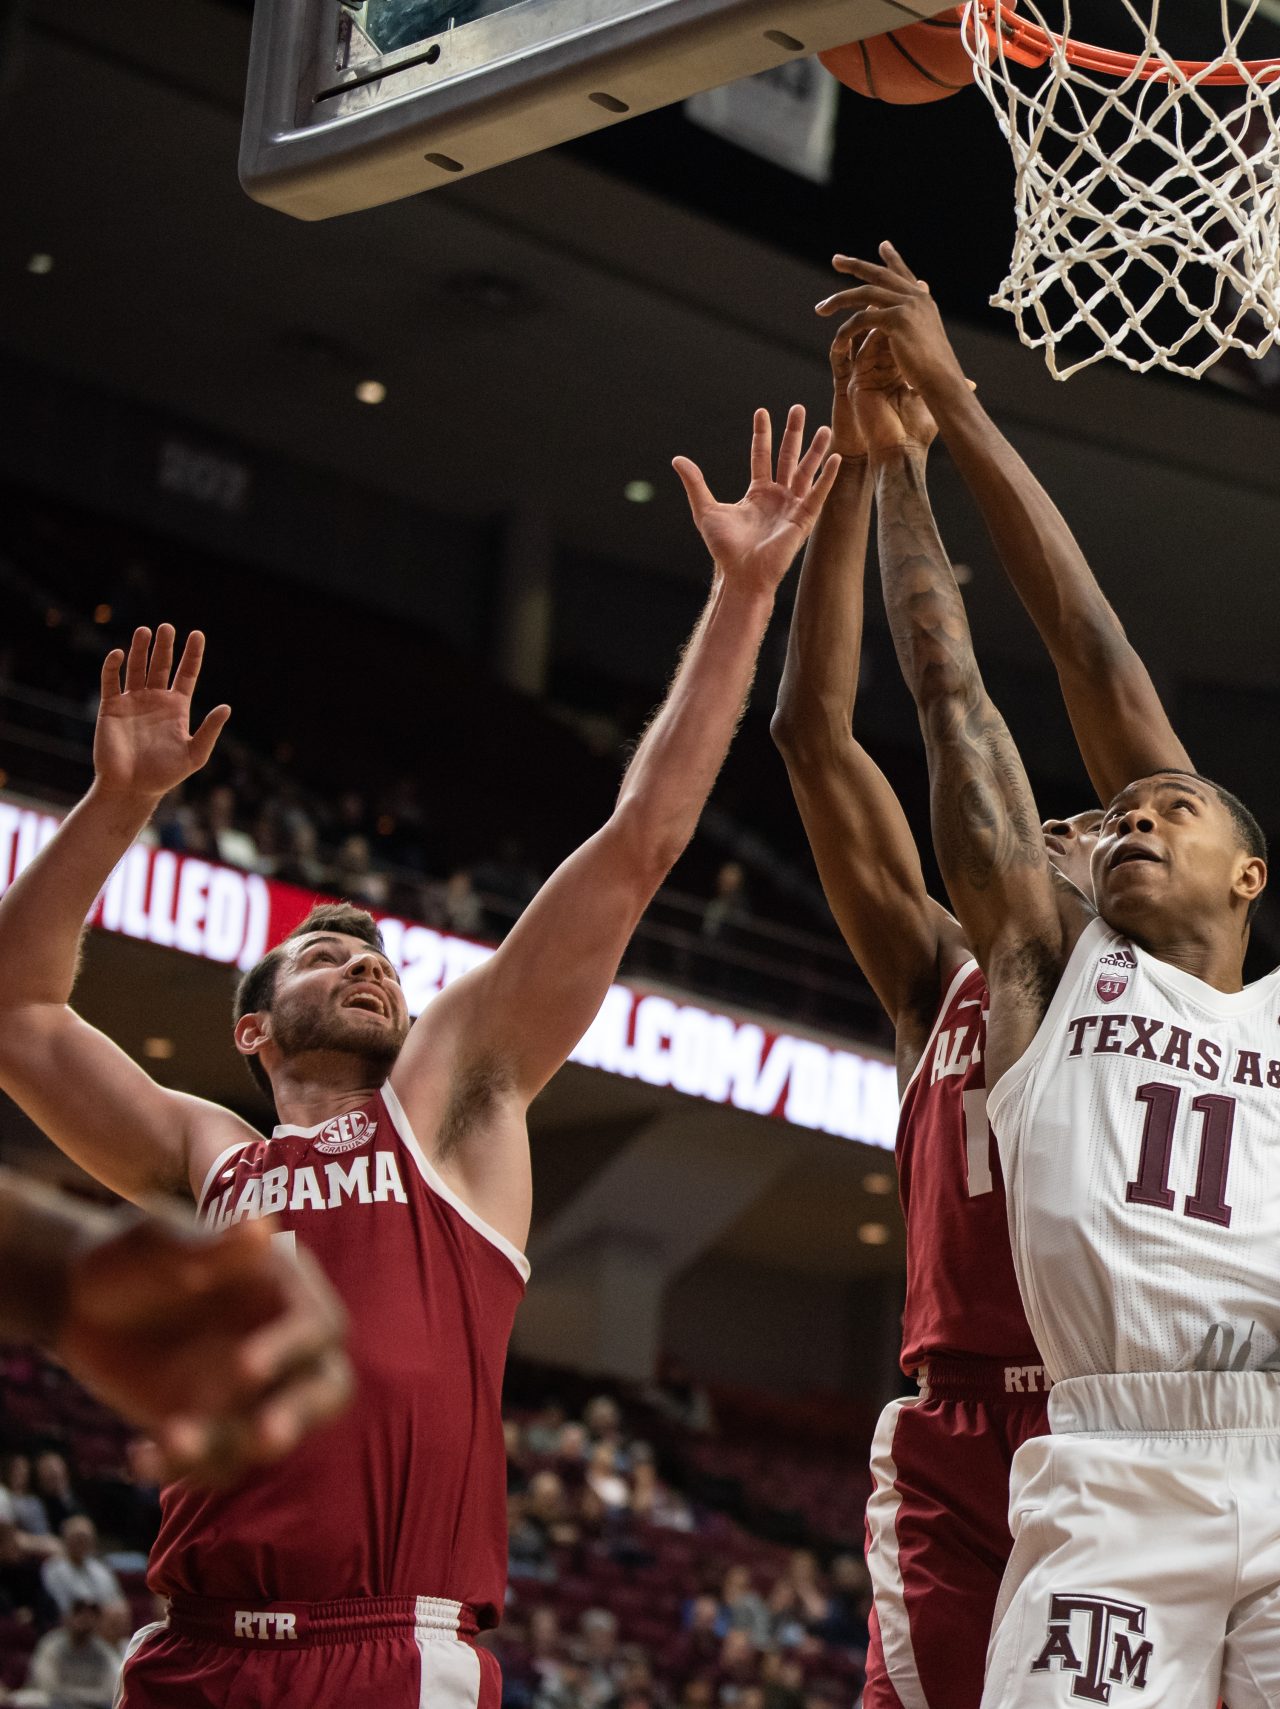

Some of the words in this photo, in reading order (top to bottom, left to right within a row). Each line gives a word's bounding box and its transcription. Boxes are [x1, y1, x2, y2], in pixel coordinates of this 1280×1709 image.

[1067, 1014, 1222, 1081] TEXAS
[320, 1128, 375, 1154] GRADUATE
[322, 1112, 366, 1143] SEC
[1125, 1081, 1237, 1229] 11
[234, 1610, 298, 1640] RTR
